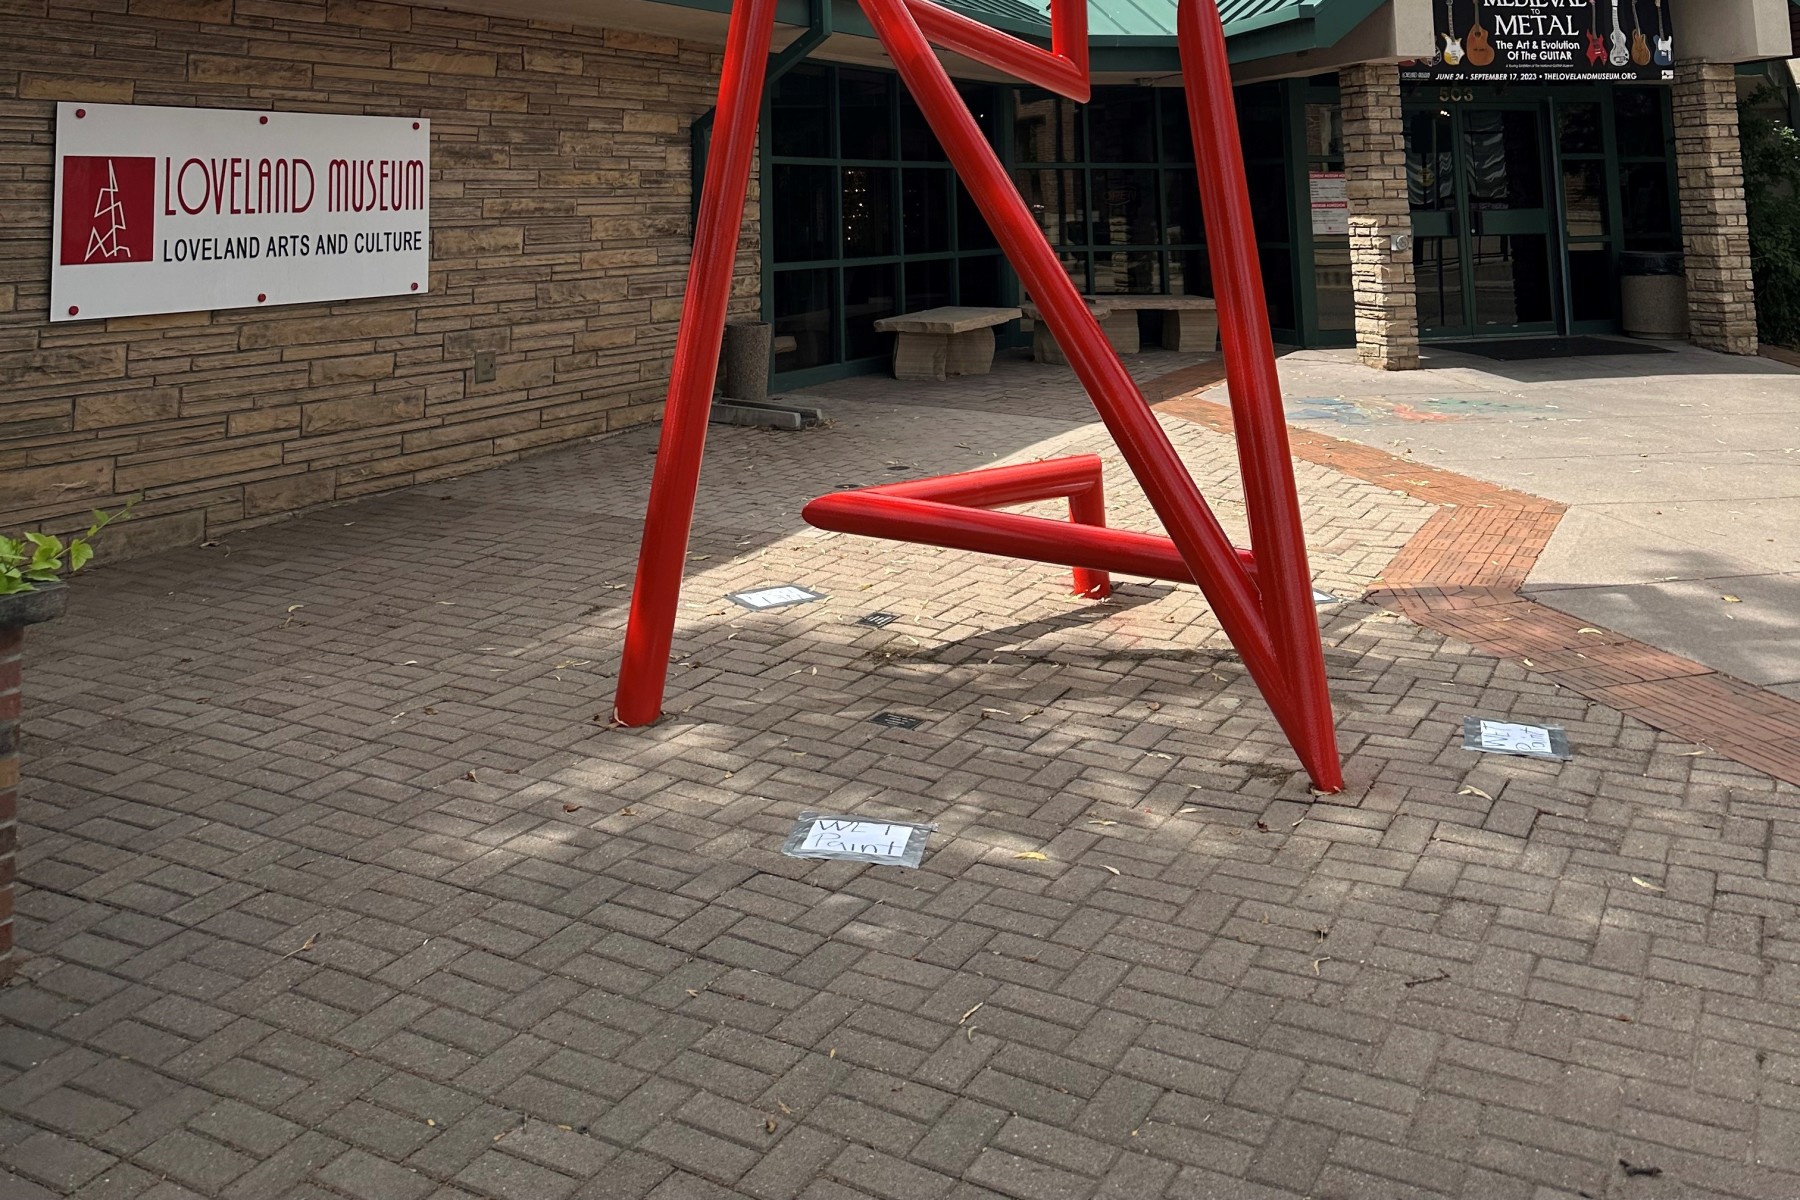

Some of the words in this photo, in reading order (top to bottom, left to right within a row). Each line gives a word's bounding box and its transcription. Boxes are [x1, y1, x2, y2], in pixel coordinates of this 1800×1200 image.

[1494, 14, 1580, 36] METAL
[1496, 40, 1513, 50] The
[1516, 40, 1530, 50] Art
[1532, 40, 1539, 50] &
[1541, 40, 1581, 50] Evolution
[1507, 51, 1519, 61] Of
[1521, 51, 1537, 61] The
[1539, 51, 1573, 61] GUITAR
[1435, 73, 1454, 81] JUNE
[1470, 73, 1508, 81] SEPTEMBER
[1509, 73, 1519, 81] 17,
[1544, 72, 1637, 80] THELOVELANDMUSEUM.ORG
[1439, 86, 1474, 102] 503
[165, 157, 316, 216] LOVELAND
[328, 158, 424, 213] MUSEUM
[164, 236, 260, 262] LOVELAND
[266, 234, 310, 257] ARTS
[315, 233, 349, 255] AND
[354, 231, 423, 254] CULTURE
[812, 832, 903, 855] Paint
